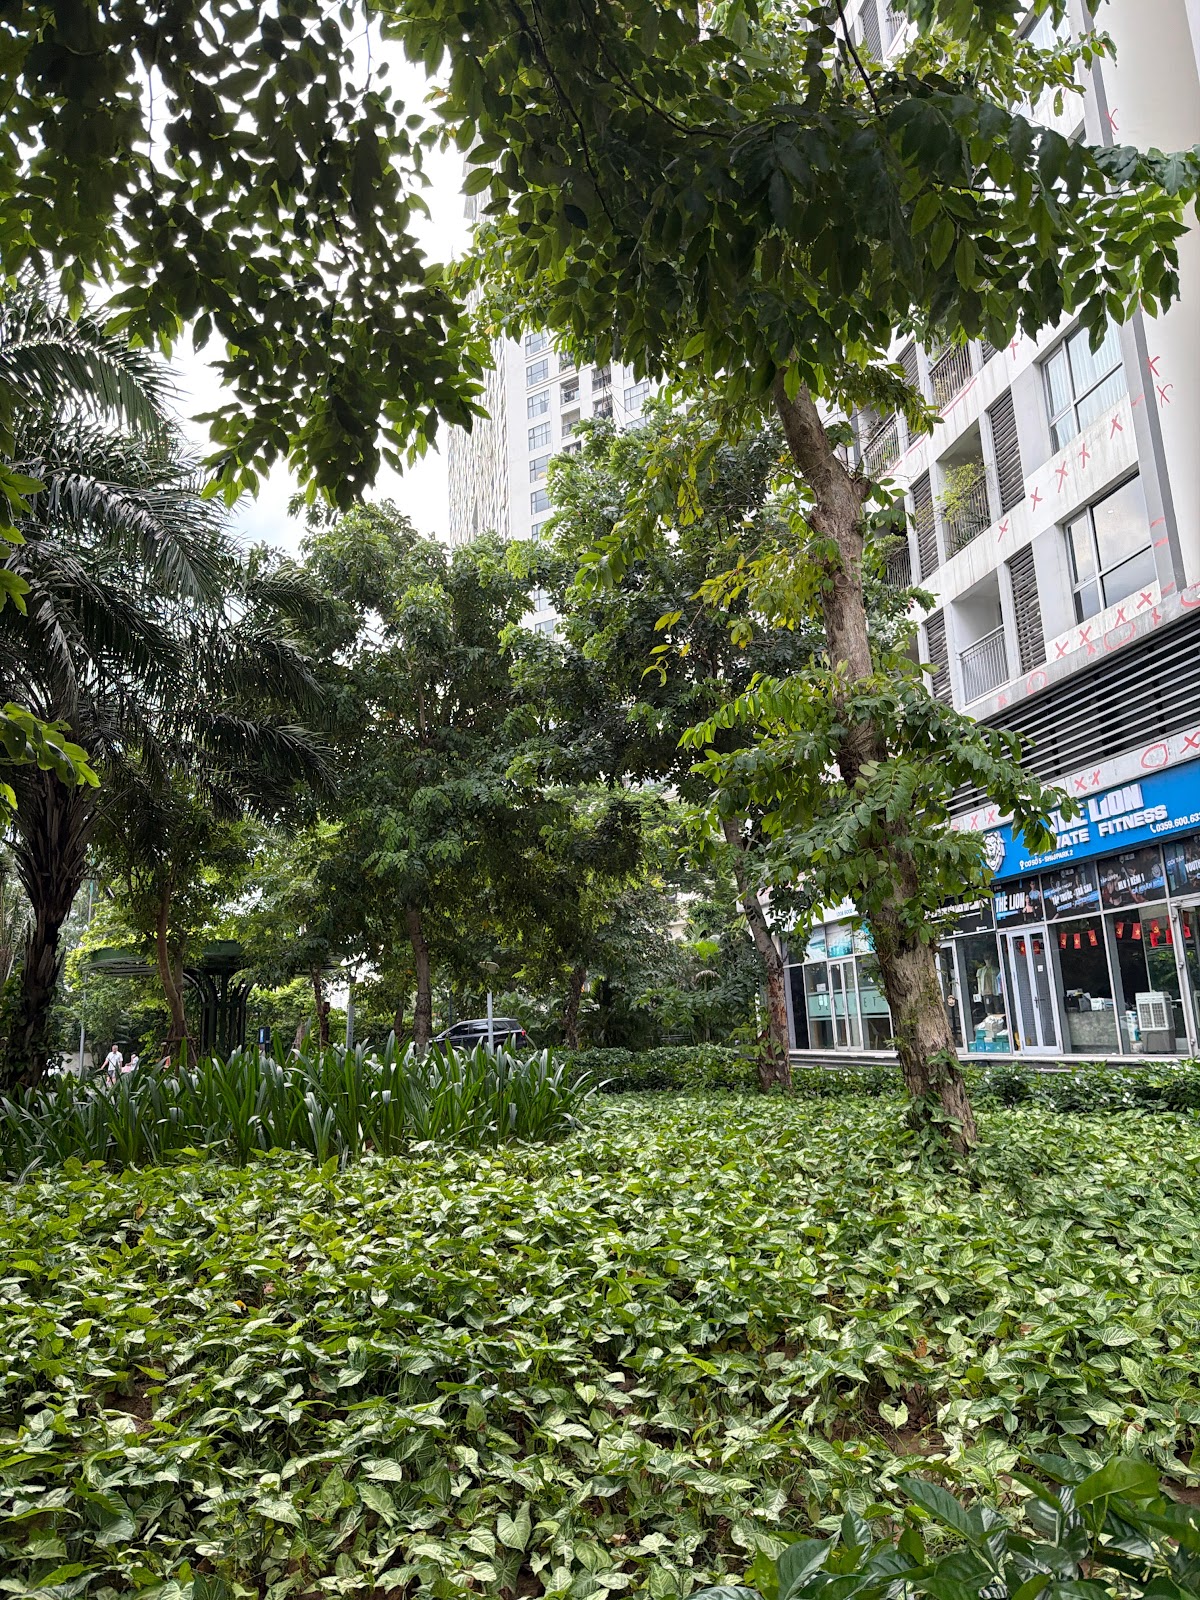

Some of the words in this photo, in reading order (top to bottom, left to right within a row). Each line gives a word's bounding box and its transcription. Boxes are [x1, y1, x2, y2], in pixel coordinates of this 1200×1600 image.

[1088, 783, 1144, 823] LION
[1098, 804, 1168, 837] FITNESS
[995, 896, 1008, 913] THE
[1009, 890, 1025, 911] LION
